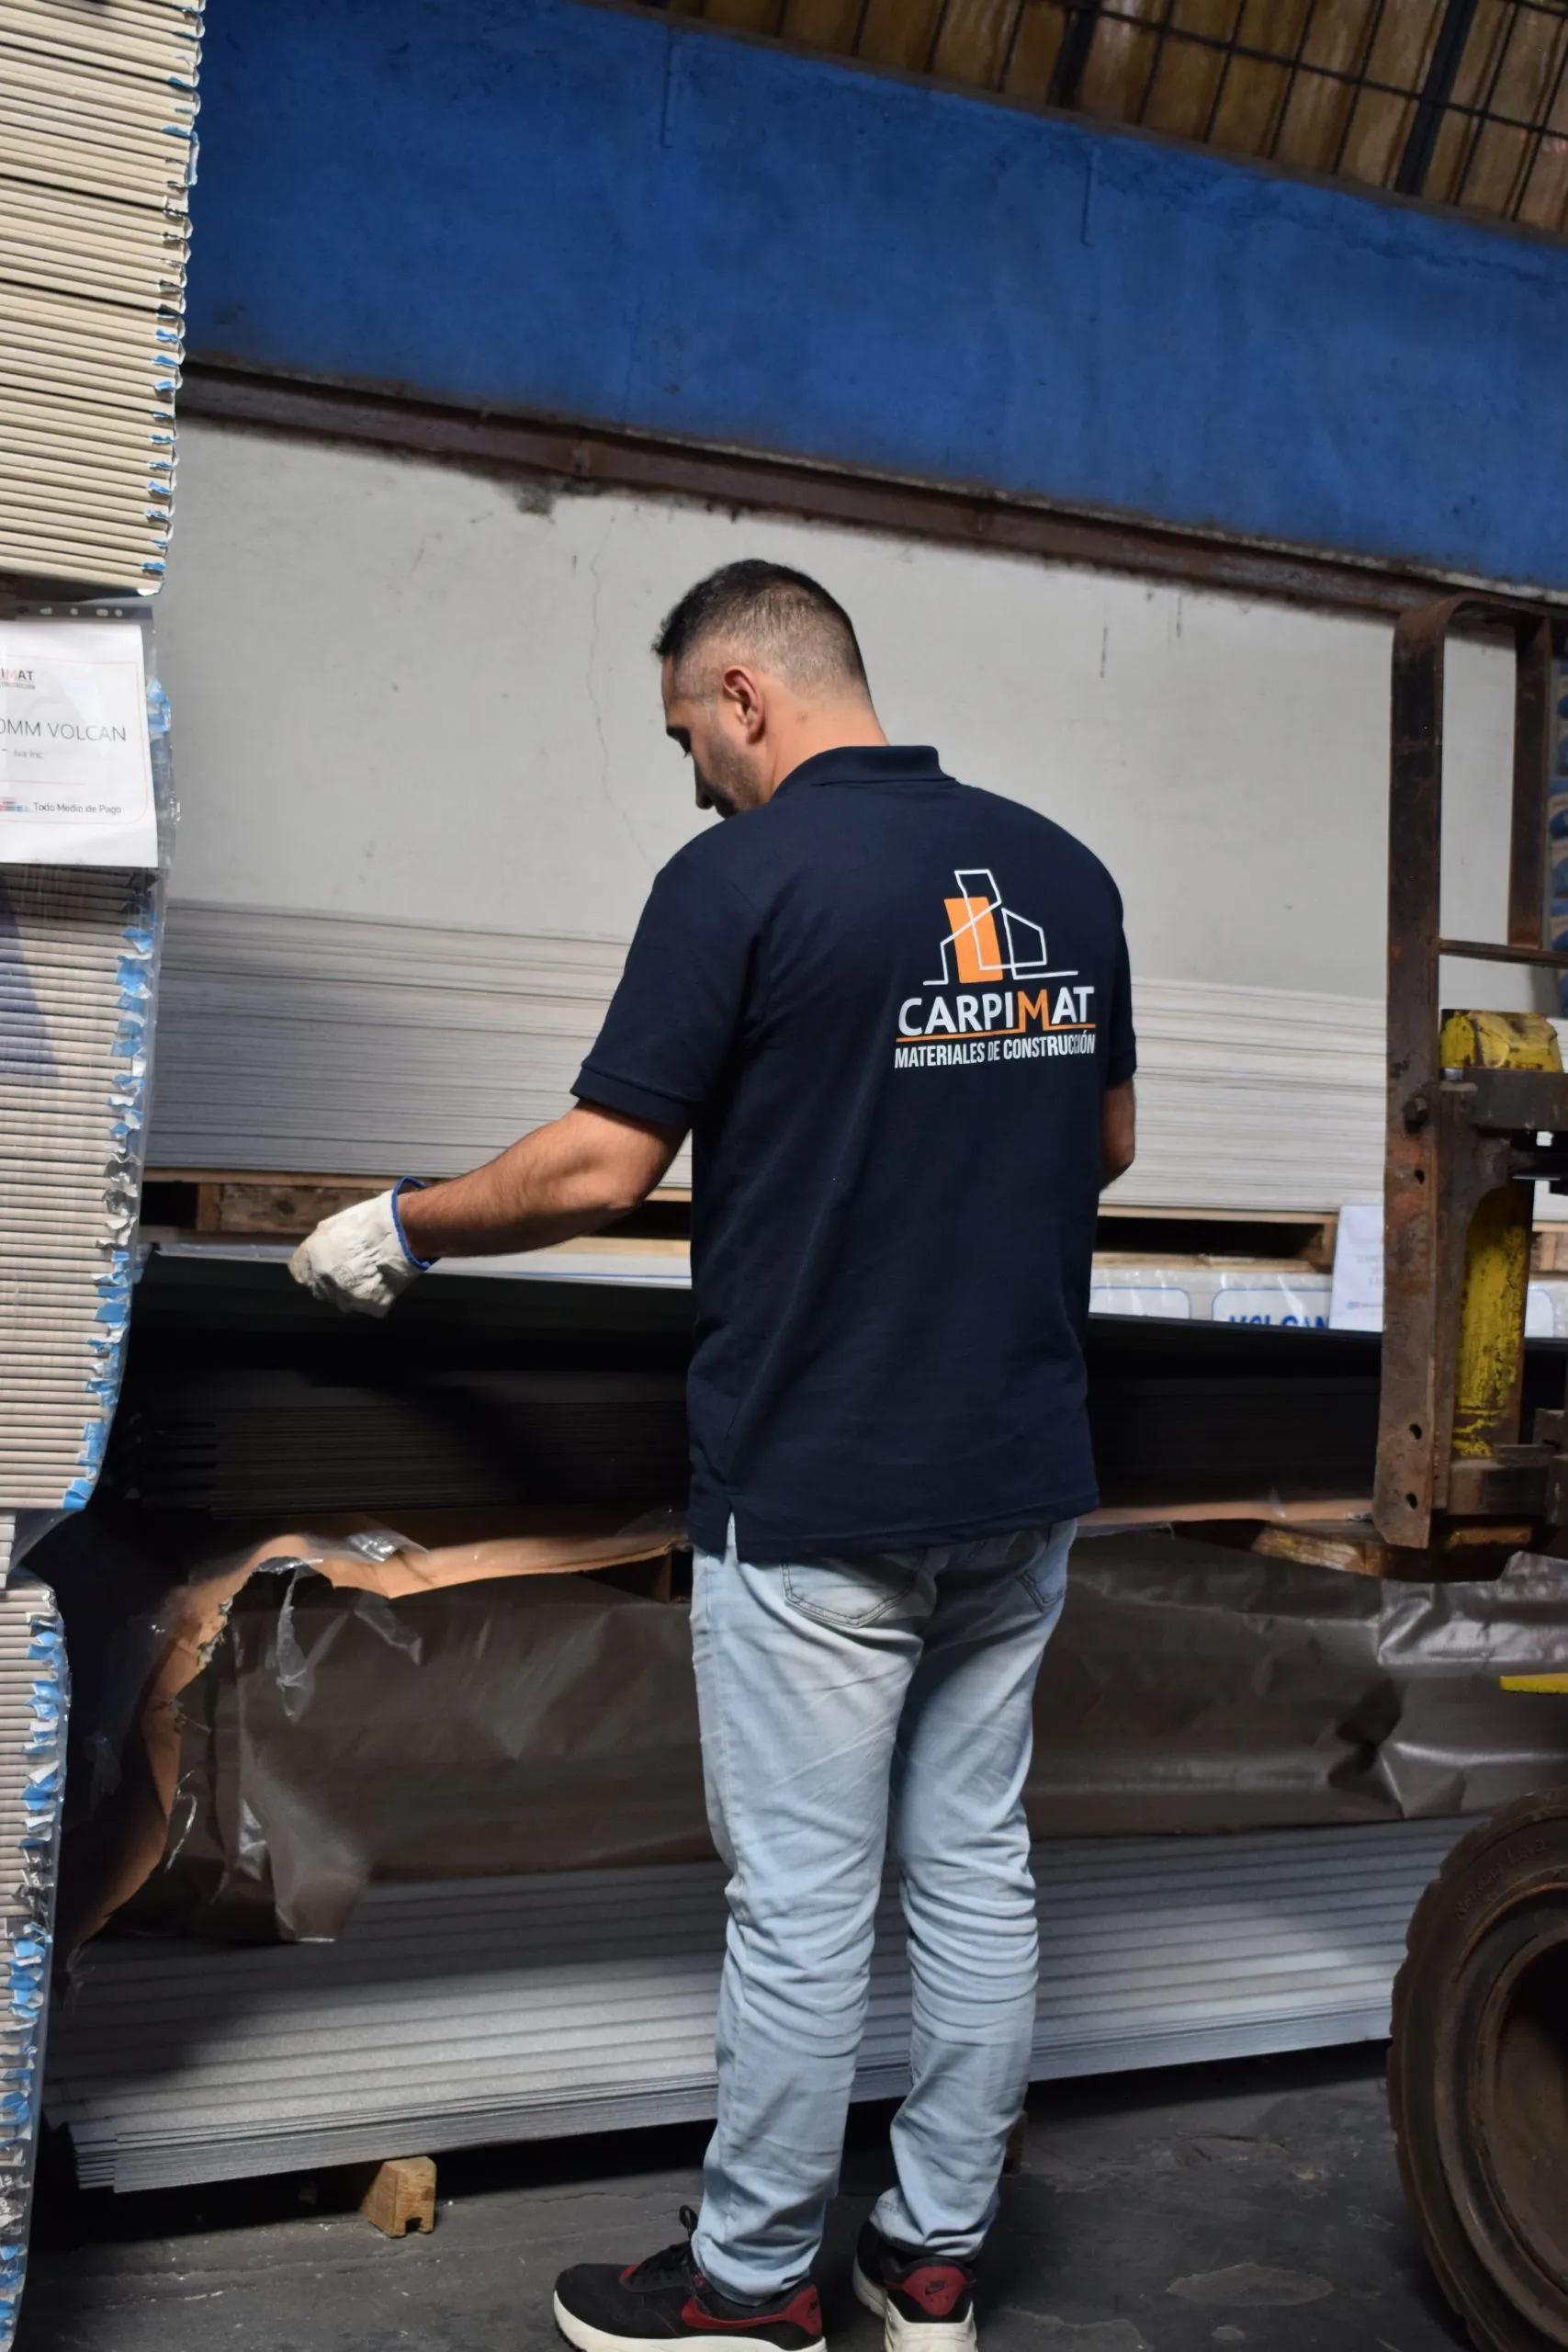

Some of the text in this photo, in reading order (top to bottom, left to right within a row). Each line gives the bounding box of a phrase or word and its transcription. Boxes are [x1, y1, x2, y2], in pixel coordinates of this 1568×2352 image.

[48, 721, 127, 742] VOLCAN
[33, 801, 121, 816] Todo Medio de Pago
[897, 986, 1096, 1037] CARPIMAT
[894, 1030, 1096, 1069] MATERIALES DE CONSTRUCCIÓN
